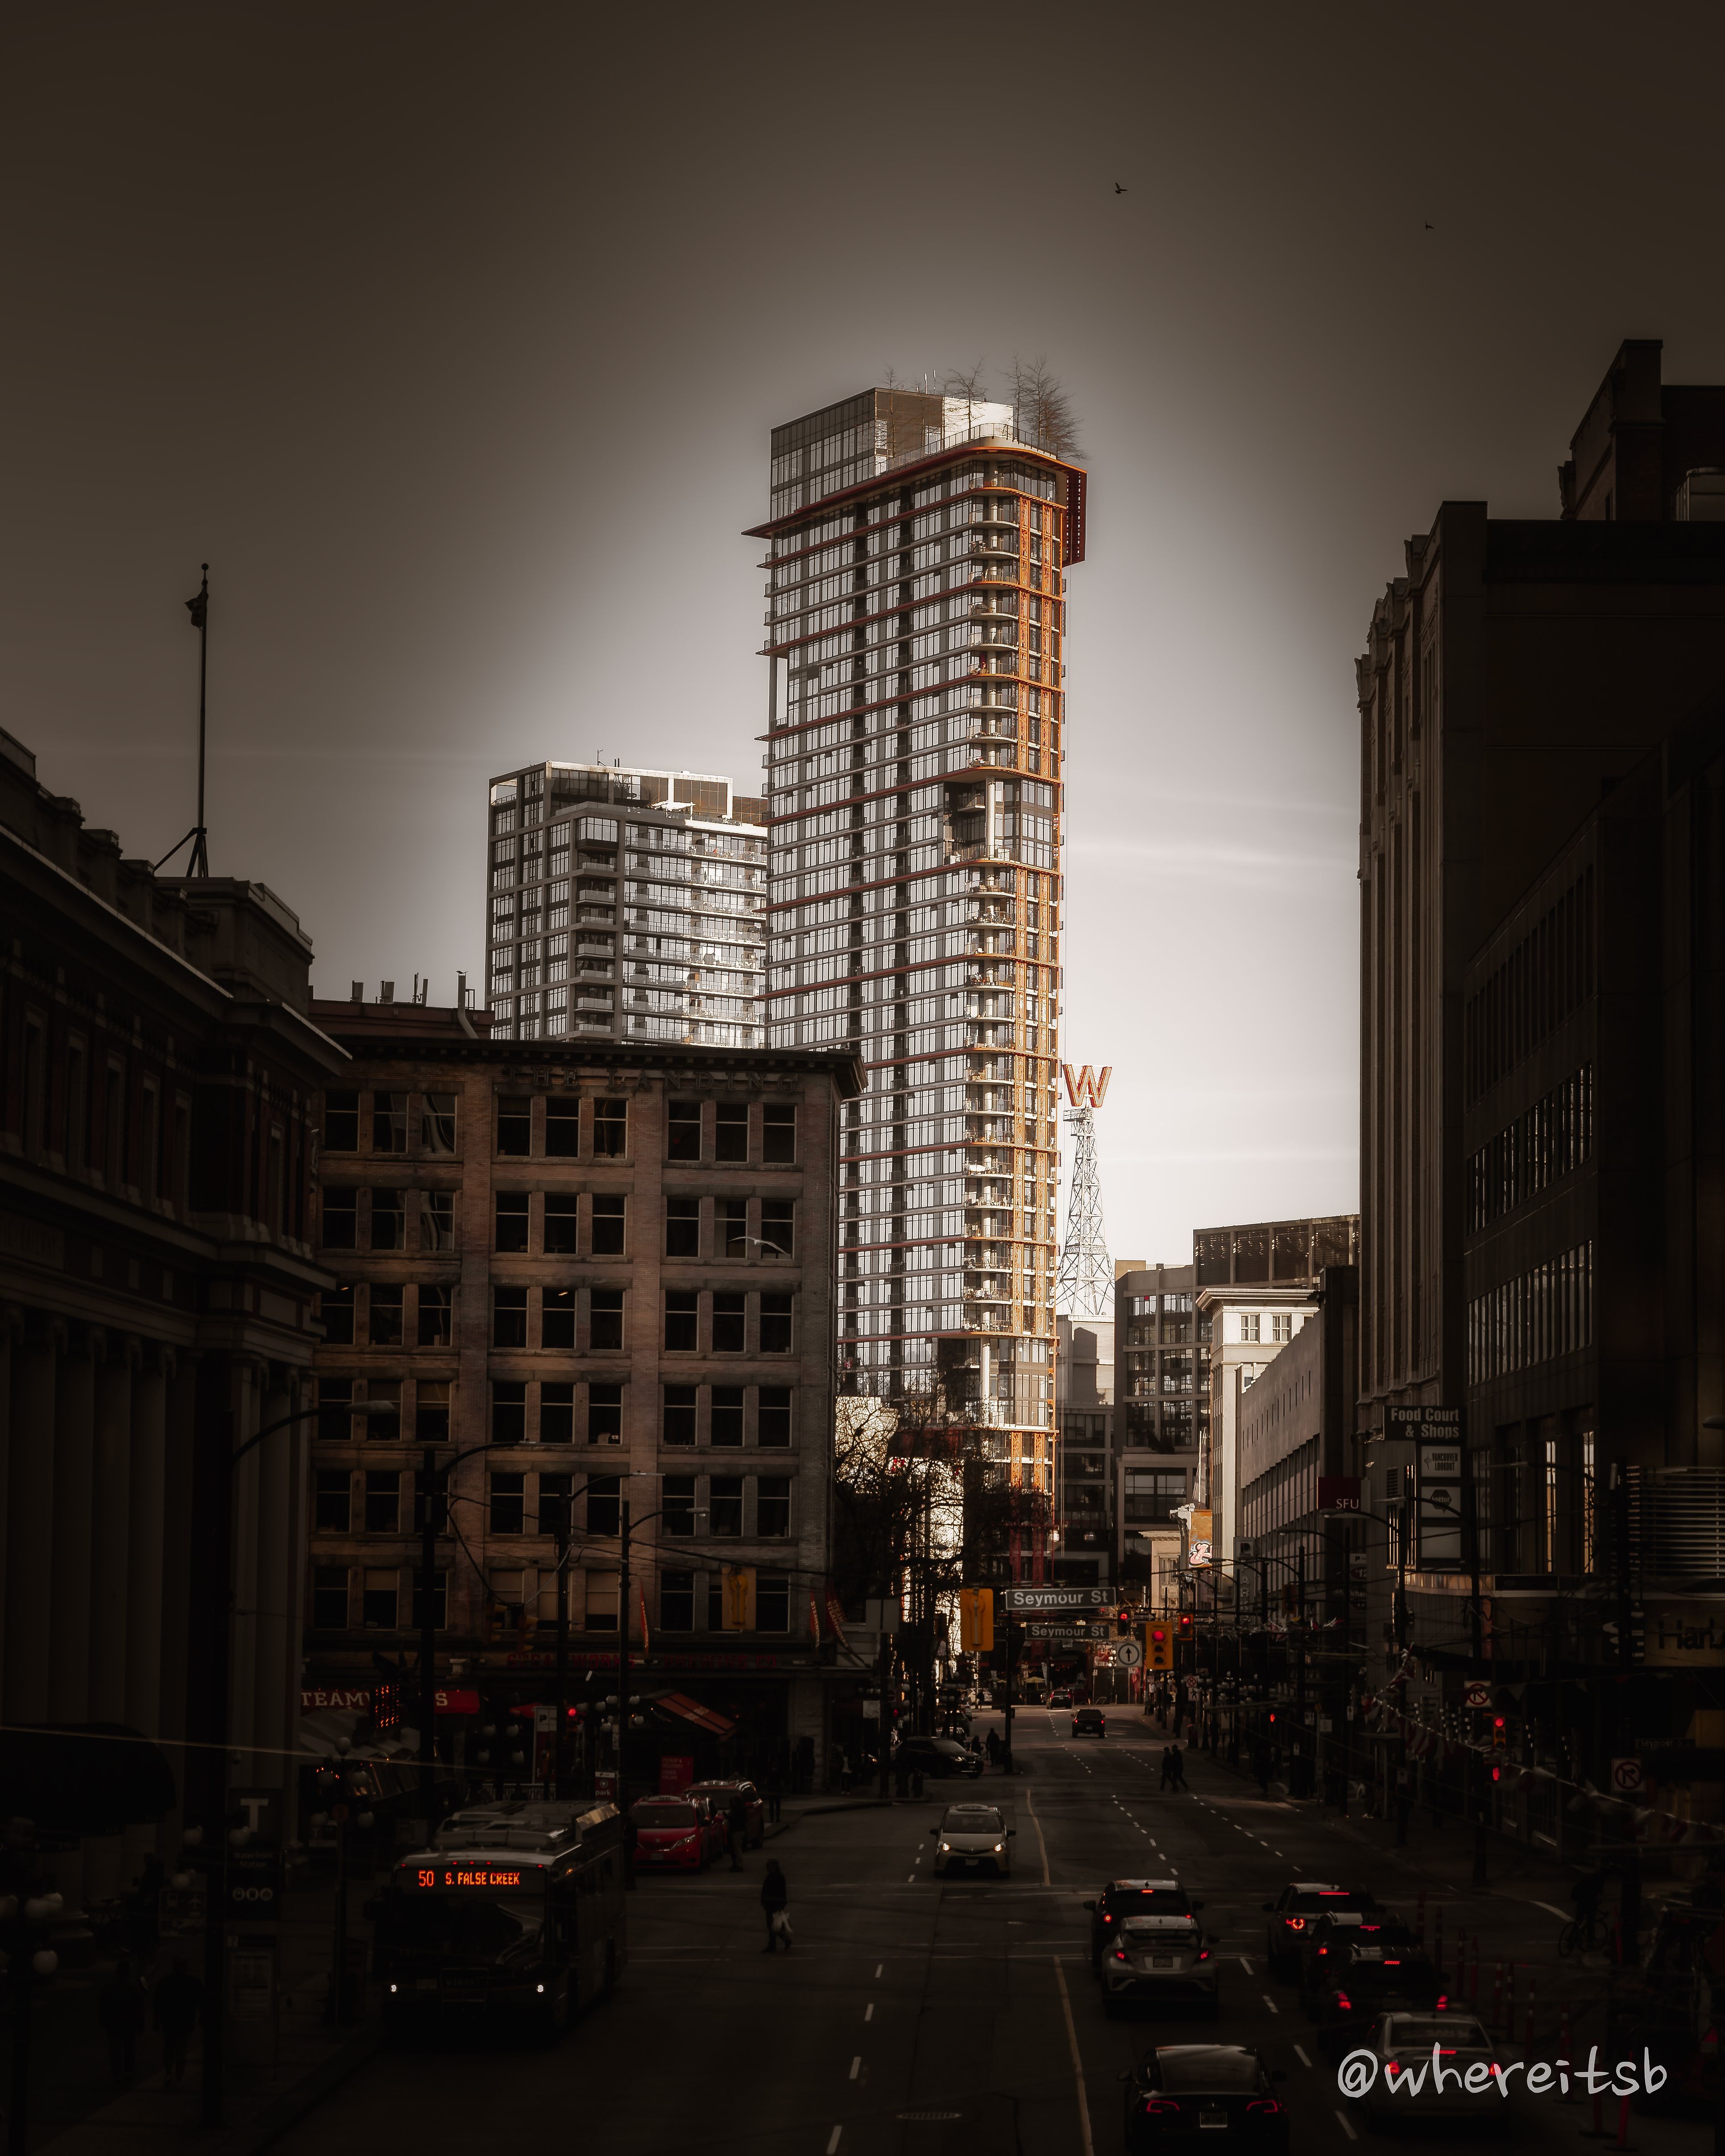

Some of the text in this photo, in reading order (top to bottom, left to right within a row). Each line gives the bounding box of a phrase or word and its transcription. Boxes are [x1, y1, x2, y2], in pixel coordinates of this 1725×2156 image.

[1062, 1064, 1112, 1108] W
[1391, 1408, 1460, 1422] Food Court
[1405, 1424, 1460, 1440] & Shops
[1432, 1452, 1458, 1462] VANCOUVER
[1435, 1462, 1455, 1471] LOOKOUT
[1336, 1498, 1359, 1509] SFU
[1014, 1590, 1108, 1607] Seymour St
[1032, 1625, 1104, 1638] Seymour St
[1641, 1740, 1674, 1749] Seymour
[240, 1798, 270, 1833] T
[233, 1851, 273, 1859] Waterfront
[418, 1870, 435, 1887] 50
[458, 1872, 488, 1886] FALSE
[490, 1872, 520, 1886] CREEK
